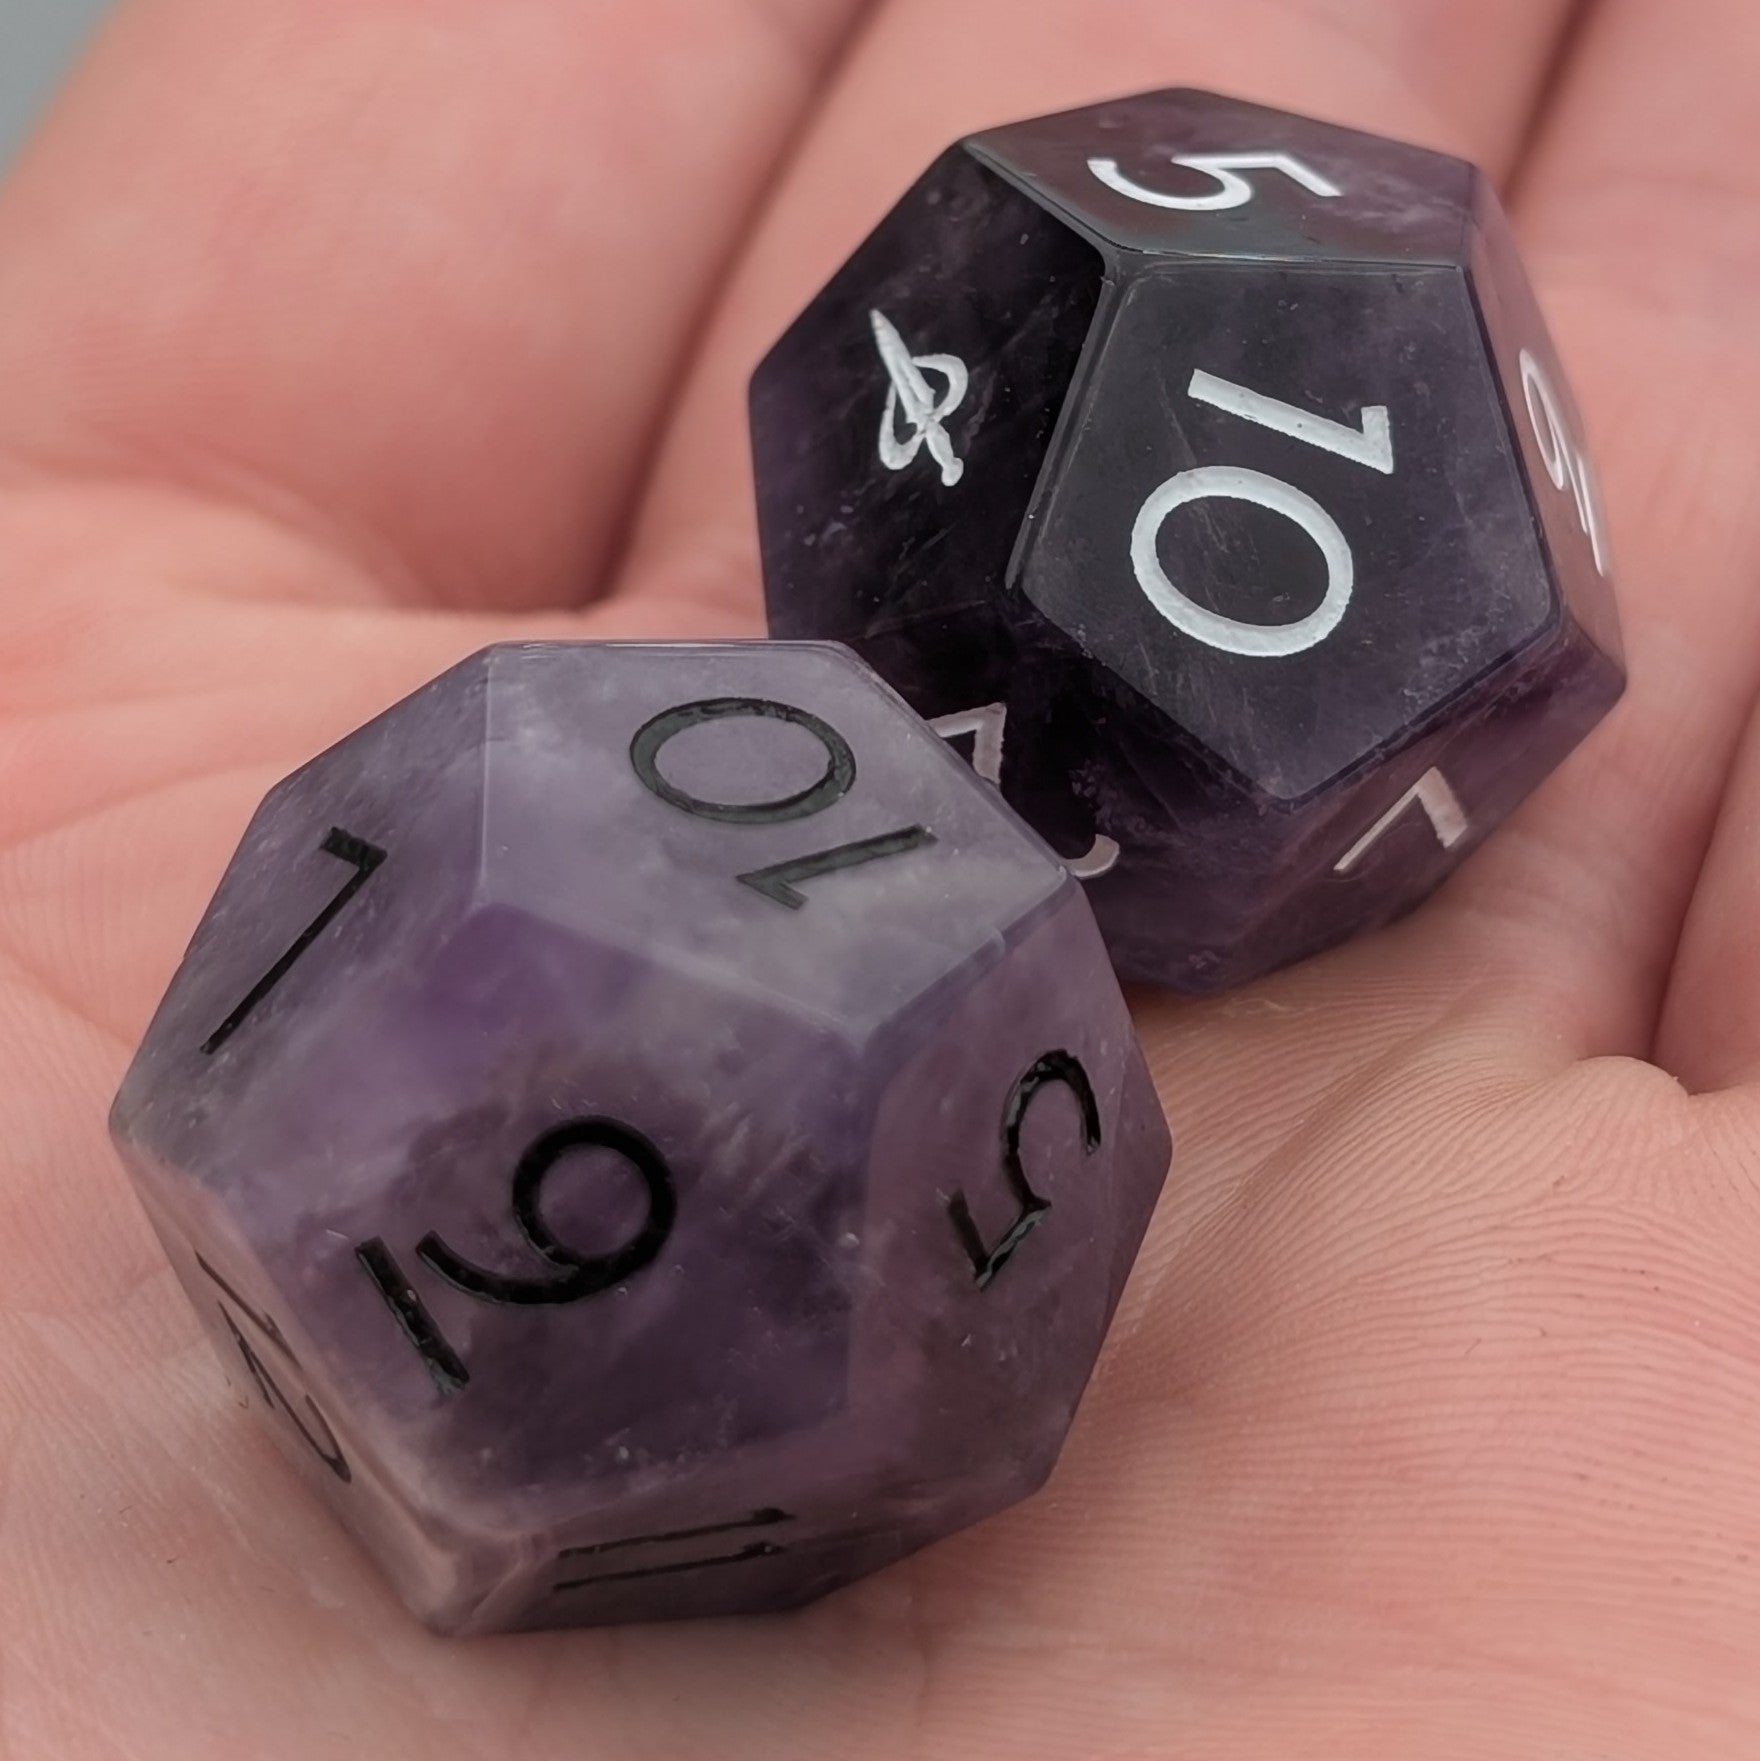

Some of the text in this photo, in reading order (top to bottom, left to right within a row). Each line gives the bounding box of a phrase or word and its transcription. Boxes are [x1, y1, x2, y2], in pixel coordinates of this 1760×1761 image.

[1087, 153, 1343, 212] 5
[1131, 369, 1393, 657] 10
[630, 697, 938, 911] 10
[1333, 766, 1468, 849] 7
[947, 1048, 1101, 1288] 5
[553, 1507, 796, 1592] 11
